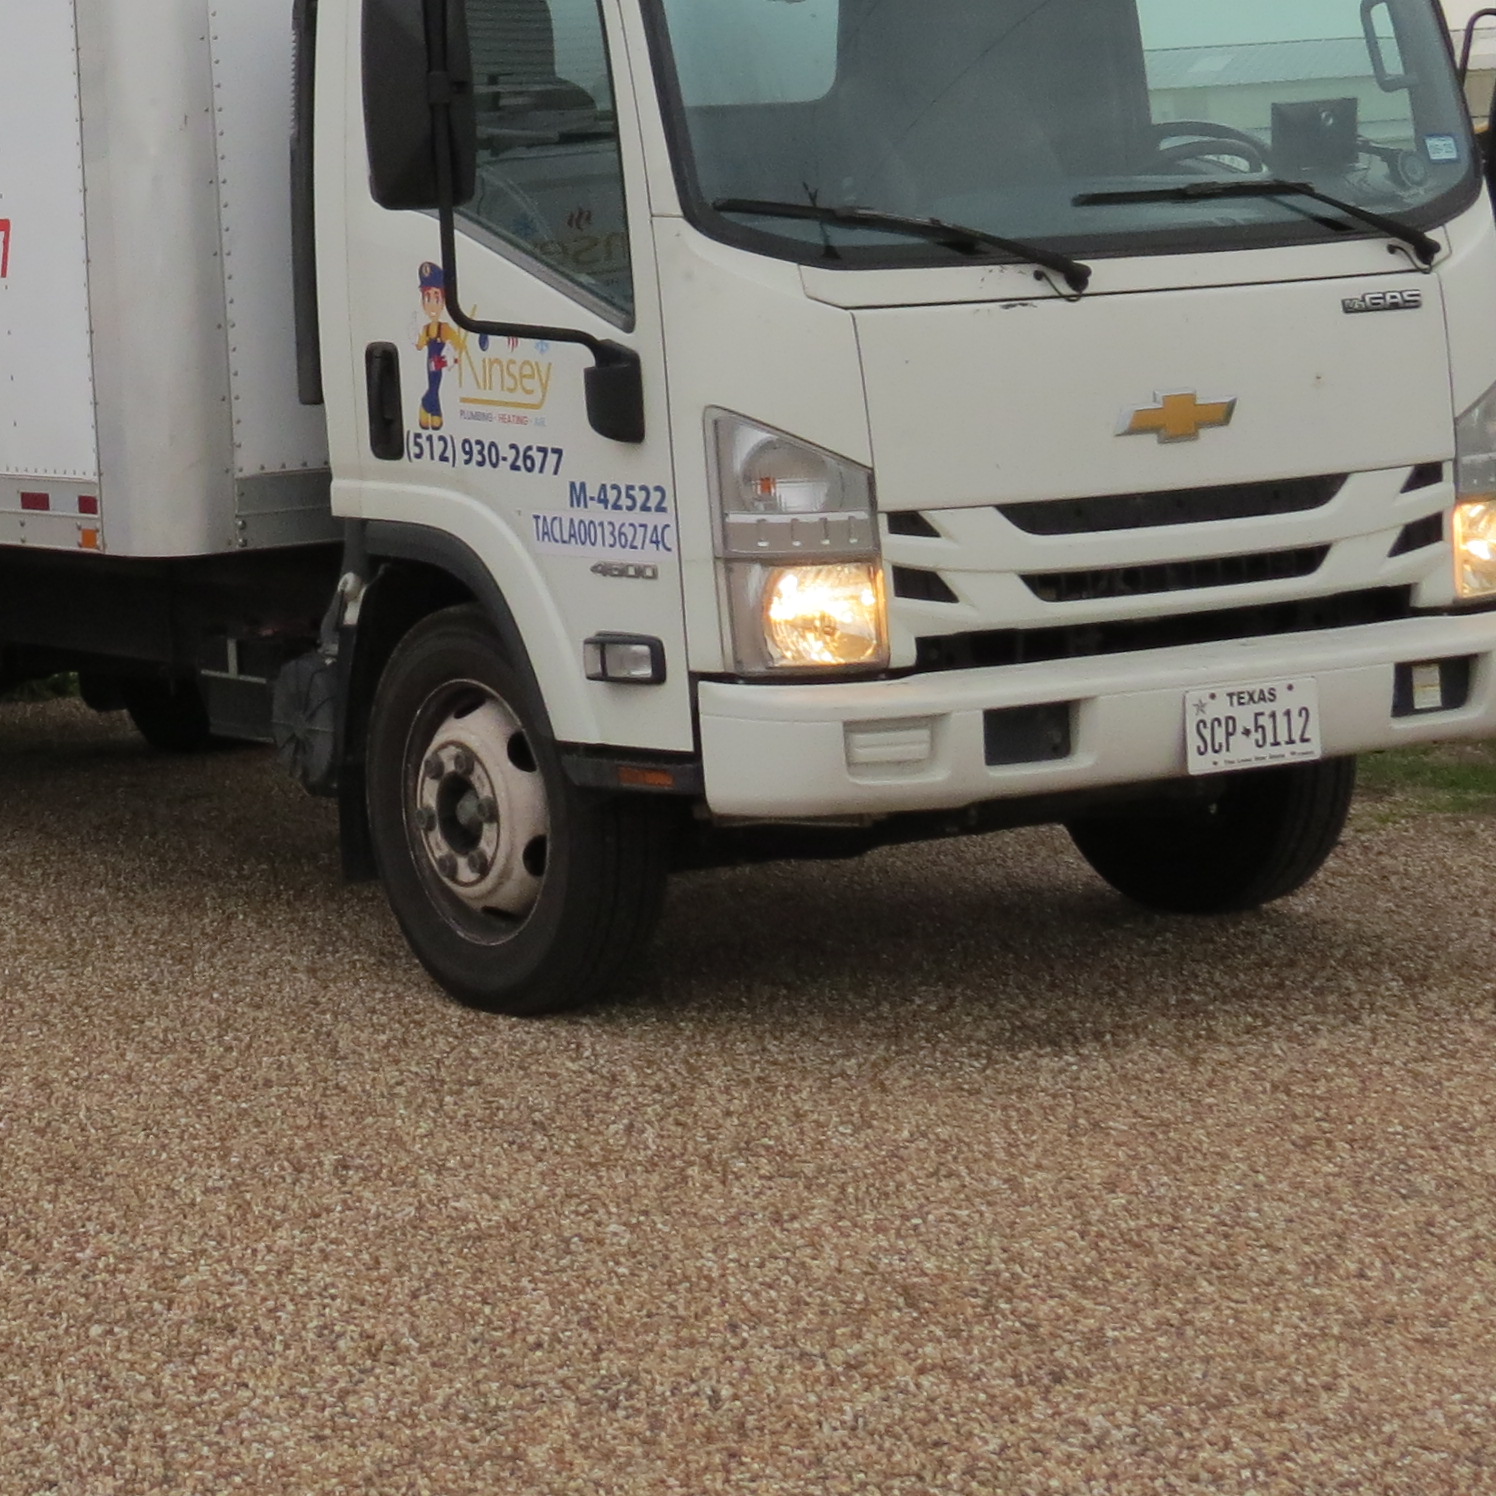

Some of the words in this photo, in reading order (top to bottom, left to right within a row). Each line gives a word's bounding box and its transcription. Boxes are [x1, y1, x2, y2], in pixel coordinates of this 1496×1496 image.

[1363, 289, 1422, 311] GAS
[406, 429, 456, 468] (512)
[461, 438, 564, 476] 930-2677
[568, 480, 668, 513] M-42522
[532, 514, 673, 552] TACLA00136274C
[1226, 687, 1278, 707] TEXAS
[1195, 715, 1238, 756] SCP
[1254, 706, 1312, 749] 5112
